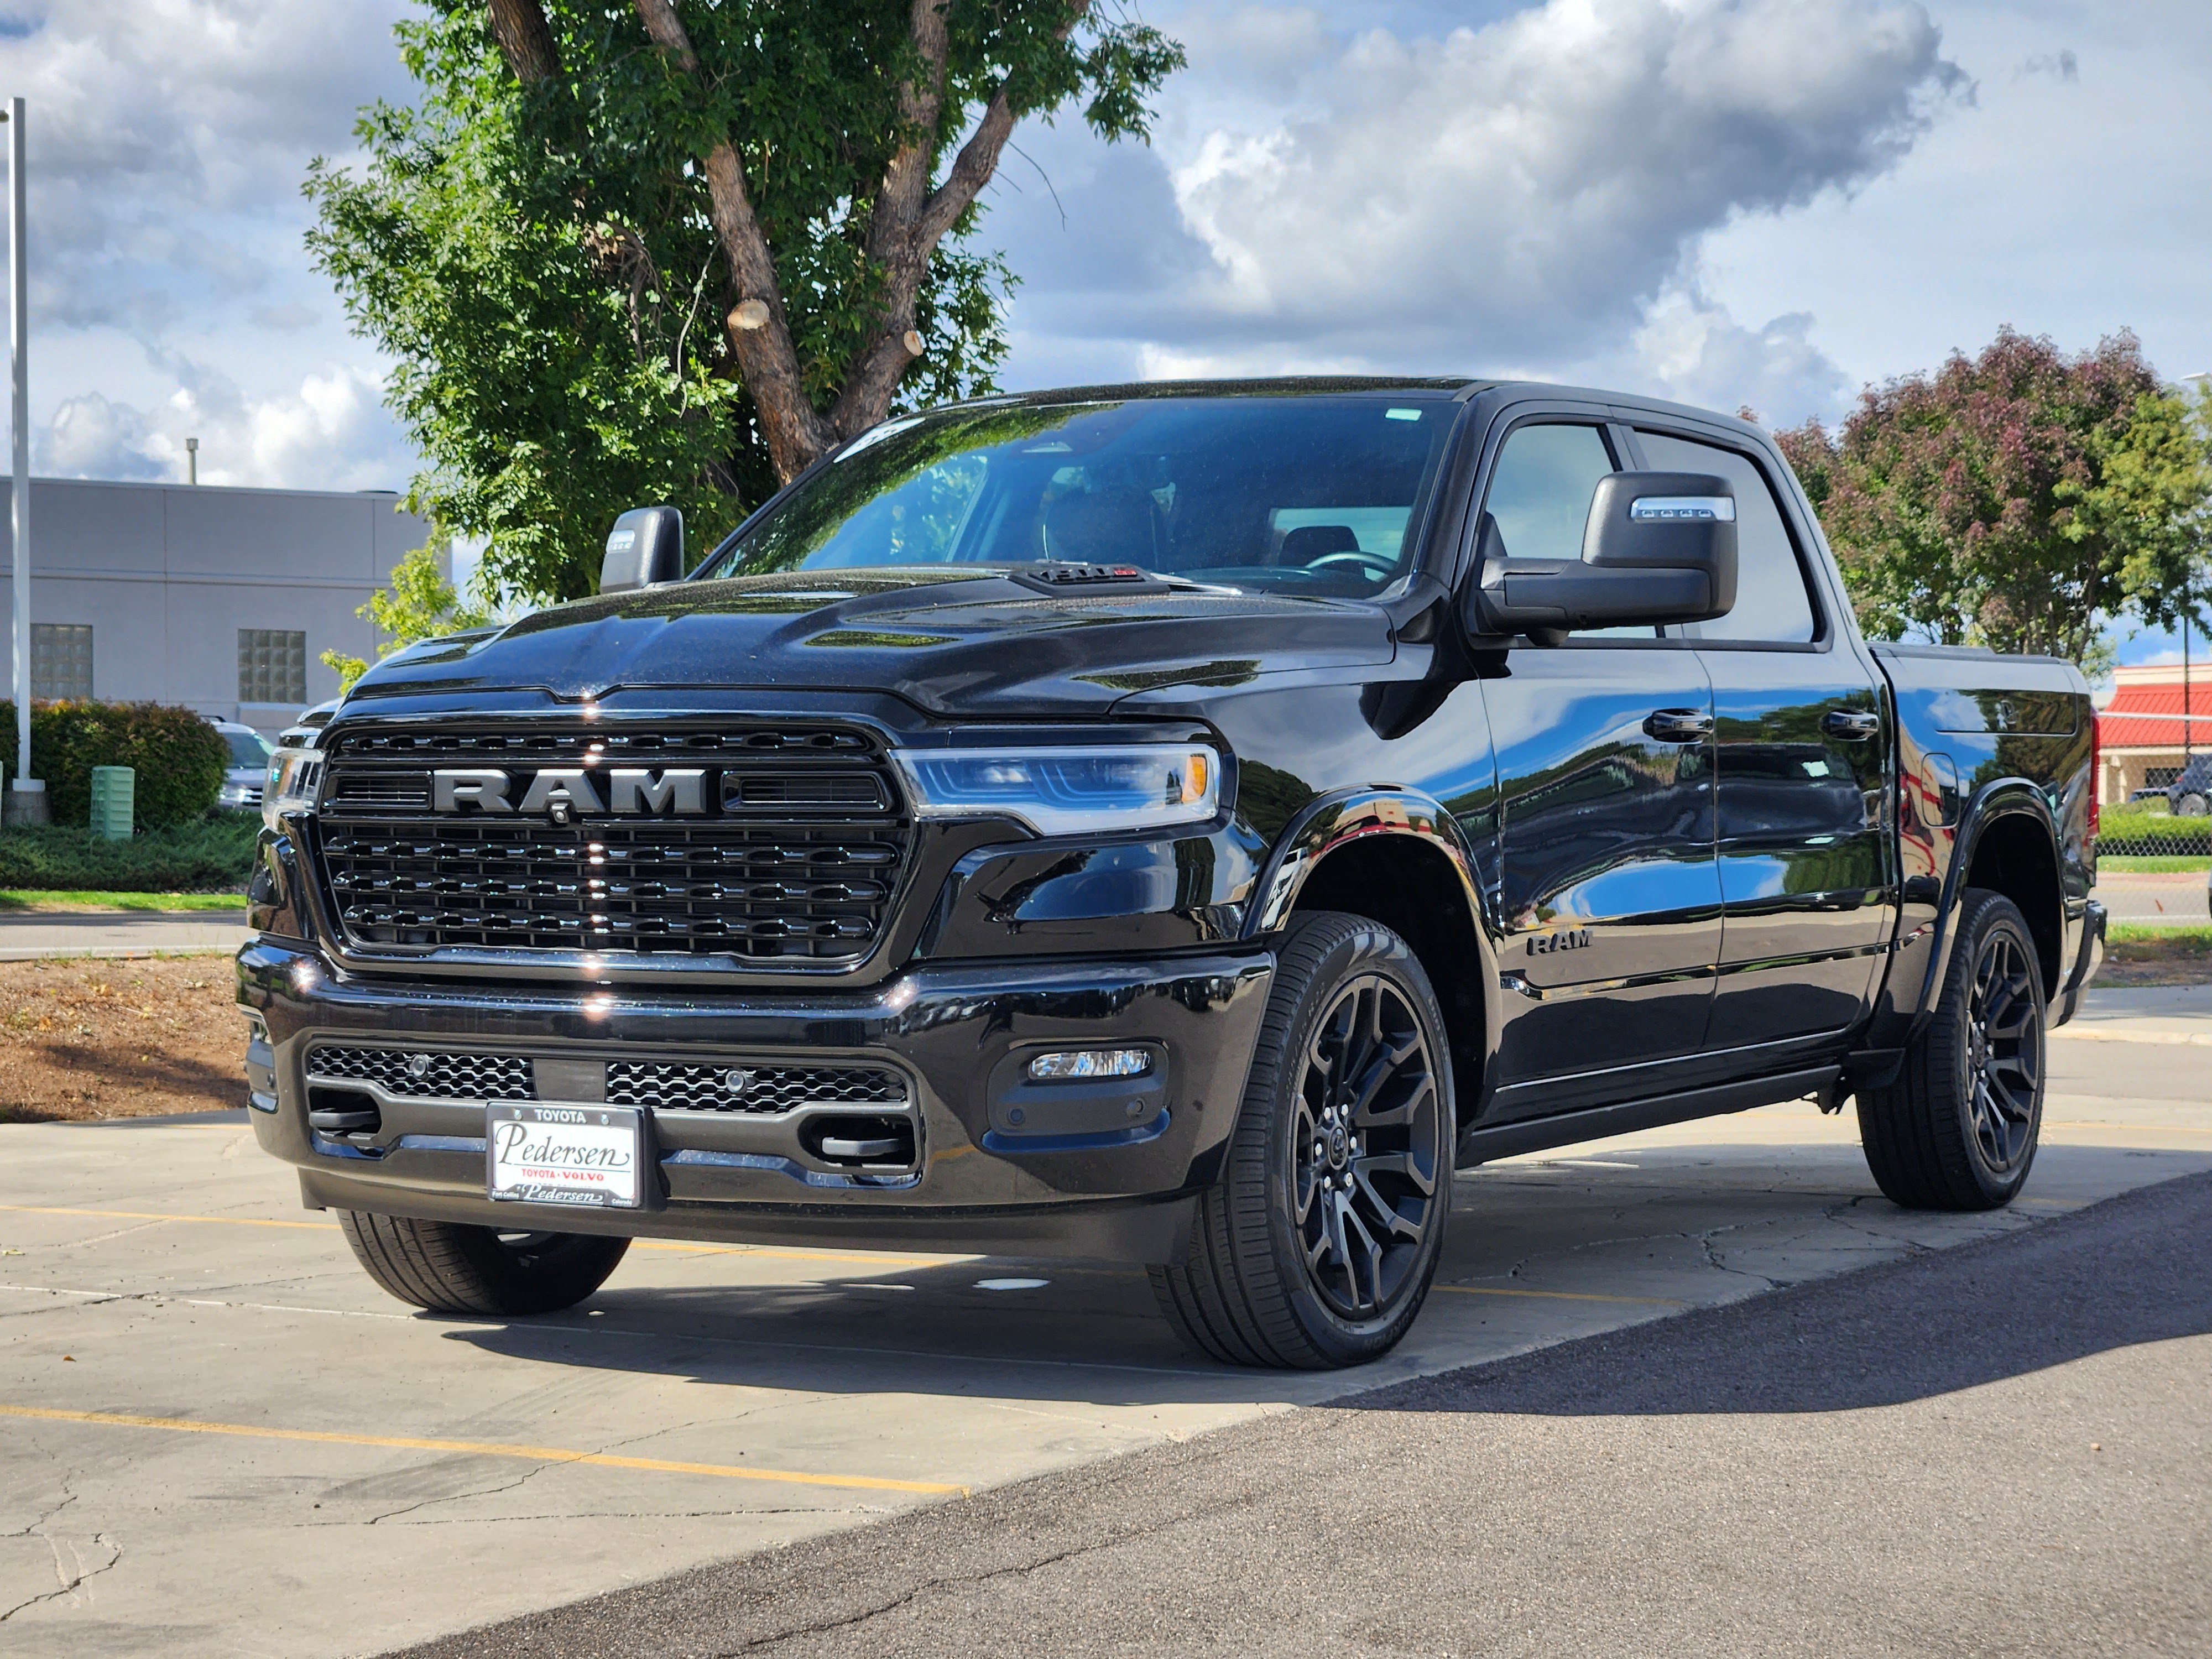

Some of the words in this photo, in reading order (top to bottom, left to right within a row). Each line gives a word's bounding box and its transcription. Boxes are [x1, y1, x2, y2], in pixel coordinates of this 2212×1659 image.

[434, 769, 707, 813] RAM
[1527, 927, 1593, 956] RAM
[534, 1109, 587, 1124] TOYOTA
[495, 1122, 630, 1167] Pedersen
[521, 1168, 555, 1178] TOYOTA
[563, 1171, 604, 1182] VOLVO
[521, 1182, 603, 1202] Pedersen
